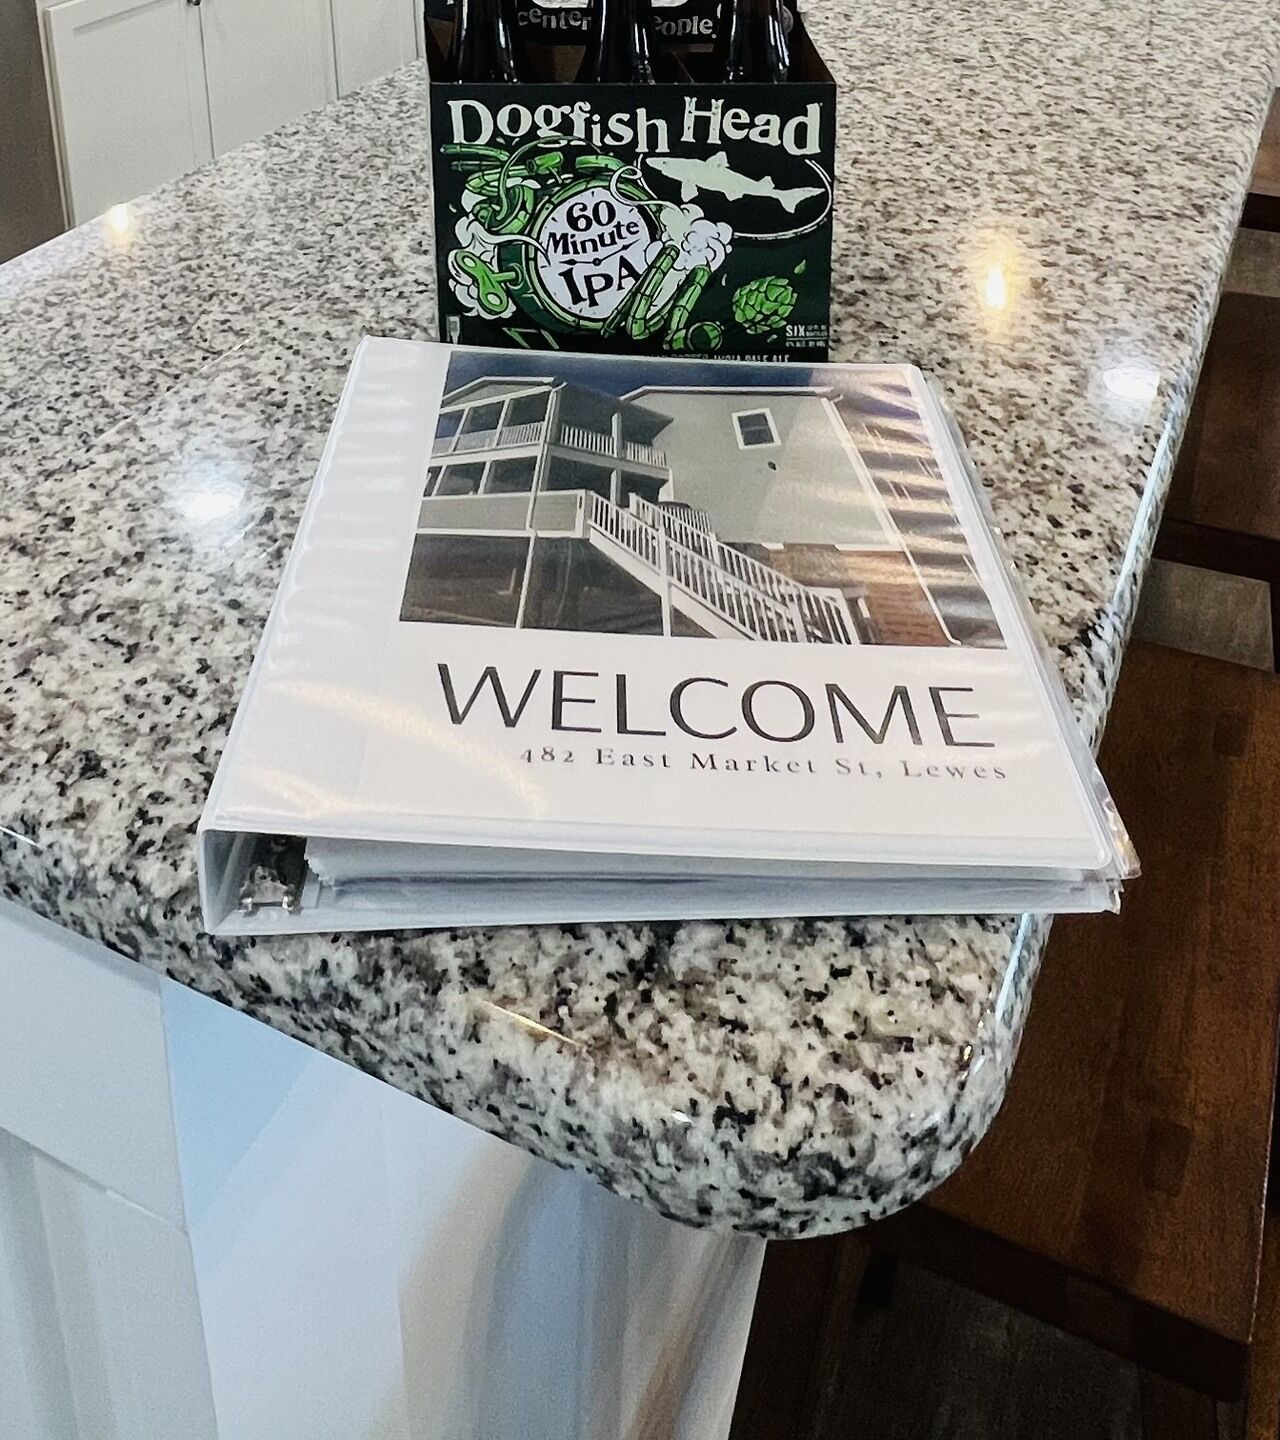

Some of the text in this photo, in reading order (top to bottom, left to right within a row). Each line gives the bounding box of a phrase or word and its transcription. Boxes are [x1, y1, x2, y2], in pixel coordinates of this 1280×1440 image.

[446, 95, 823, 156] Dogfish Head
[566, 200, 617, 232] 60
[545, 220, 640, 255] Minute
[558, 255, 642, 308] IPA
[785, 324, 806, 337] SIX
[436, 662, 996, 748] WELCOME
[520, 745, 1007, 780] 482 East Market St, Lewes
